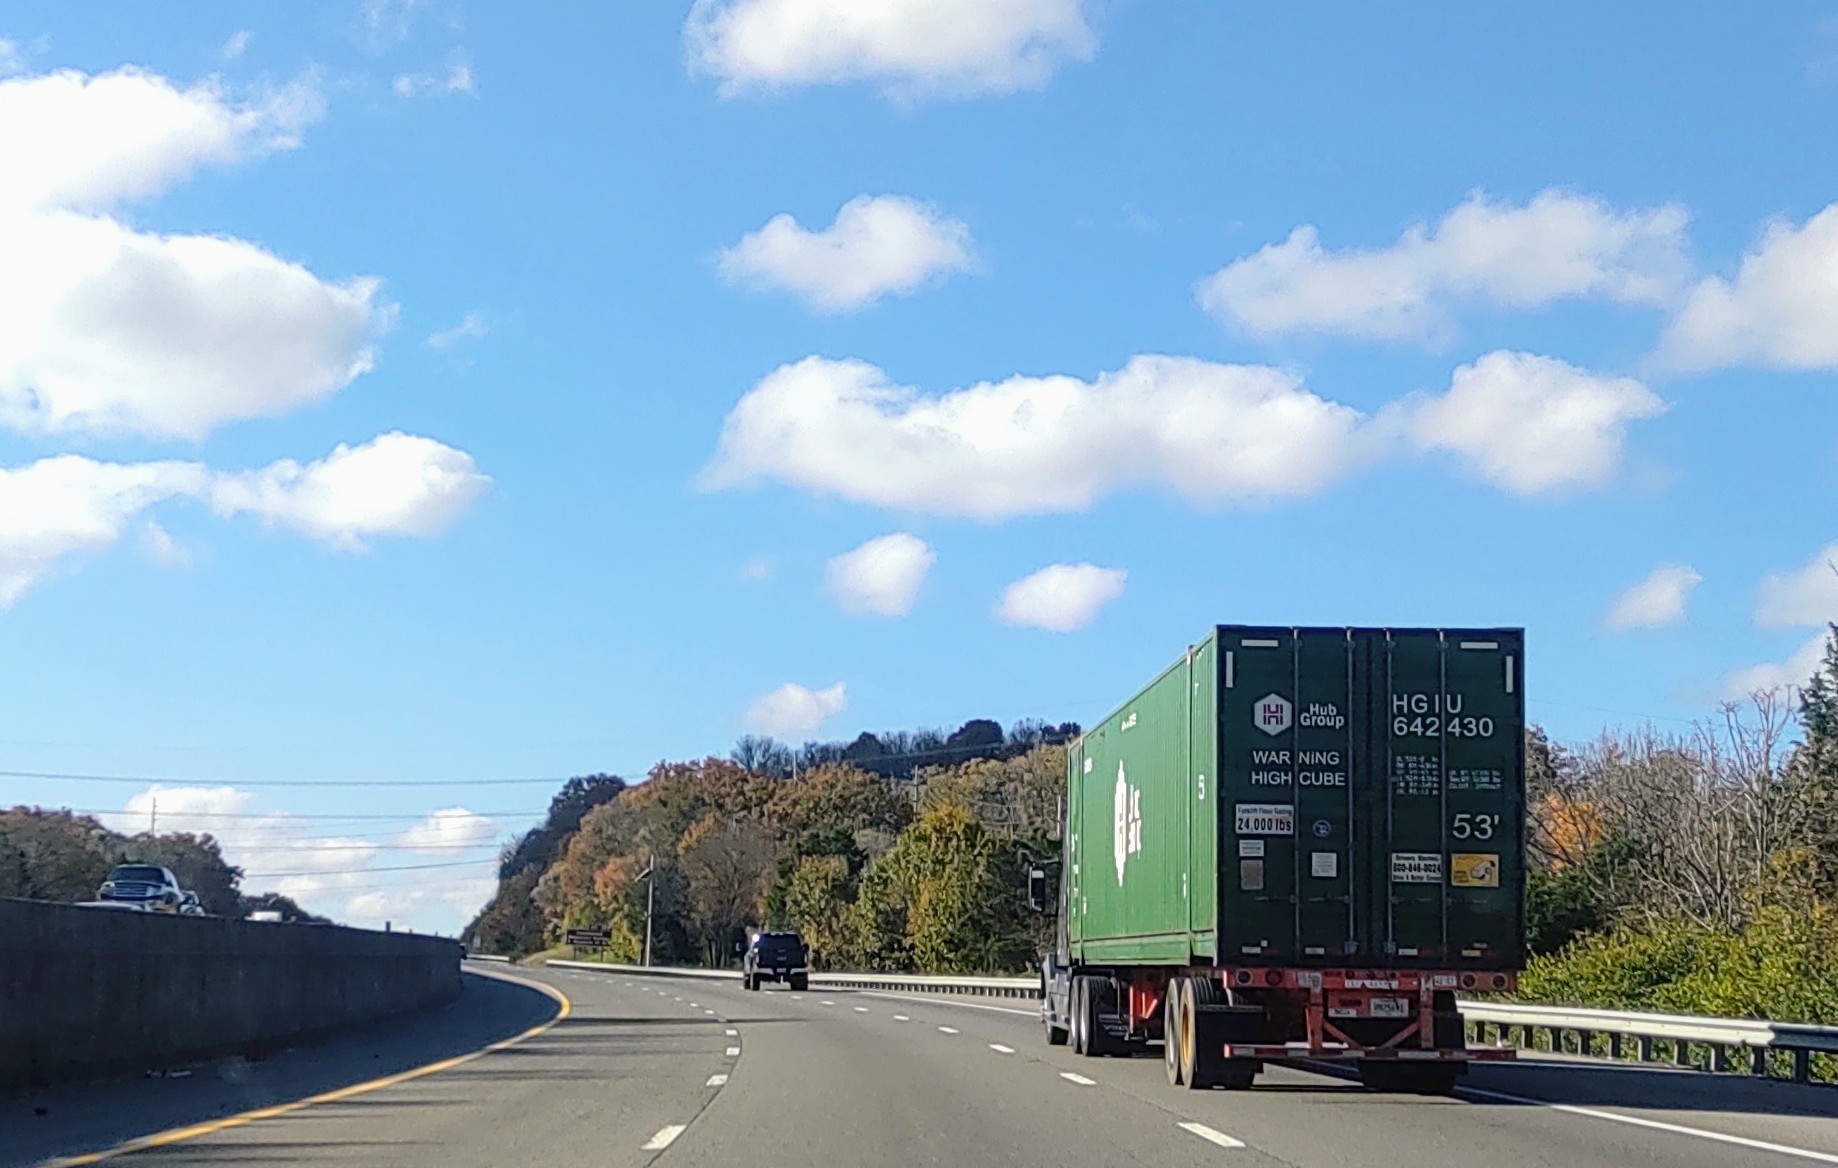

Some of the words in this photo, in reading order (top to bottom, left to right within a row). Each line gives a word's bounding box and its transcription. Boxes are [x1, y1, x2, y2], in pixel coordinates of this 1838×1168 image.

[1309, 703, 1337, 716] Hub
[1392, 693, 1462, 714] HGIU
[1300, 712, 1345, 730] Group
[1251, 771, 1292, 785] HIGH
[1299, 771, 1346, 786] CUBE
[1275, 818, 1292, 832] lbs
[1452, 813, 1500, 839] 53'
